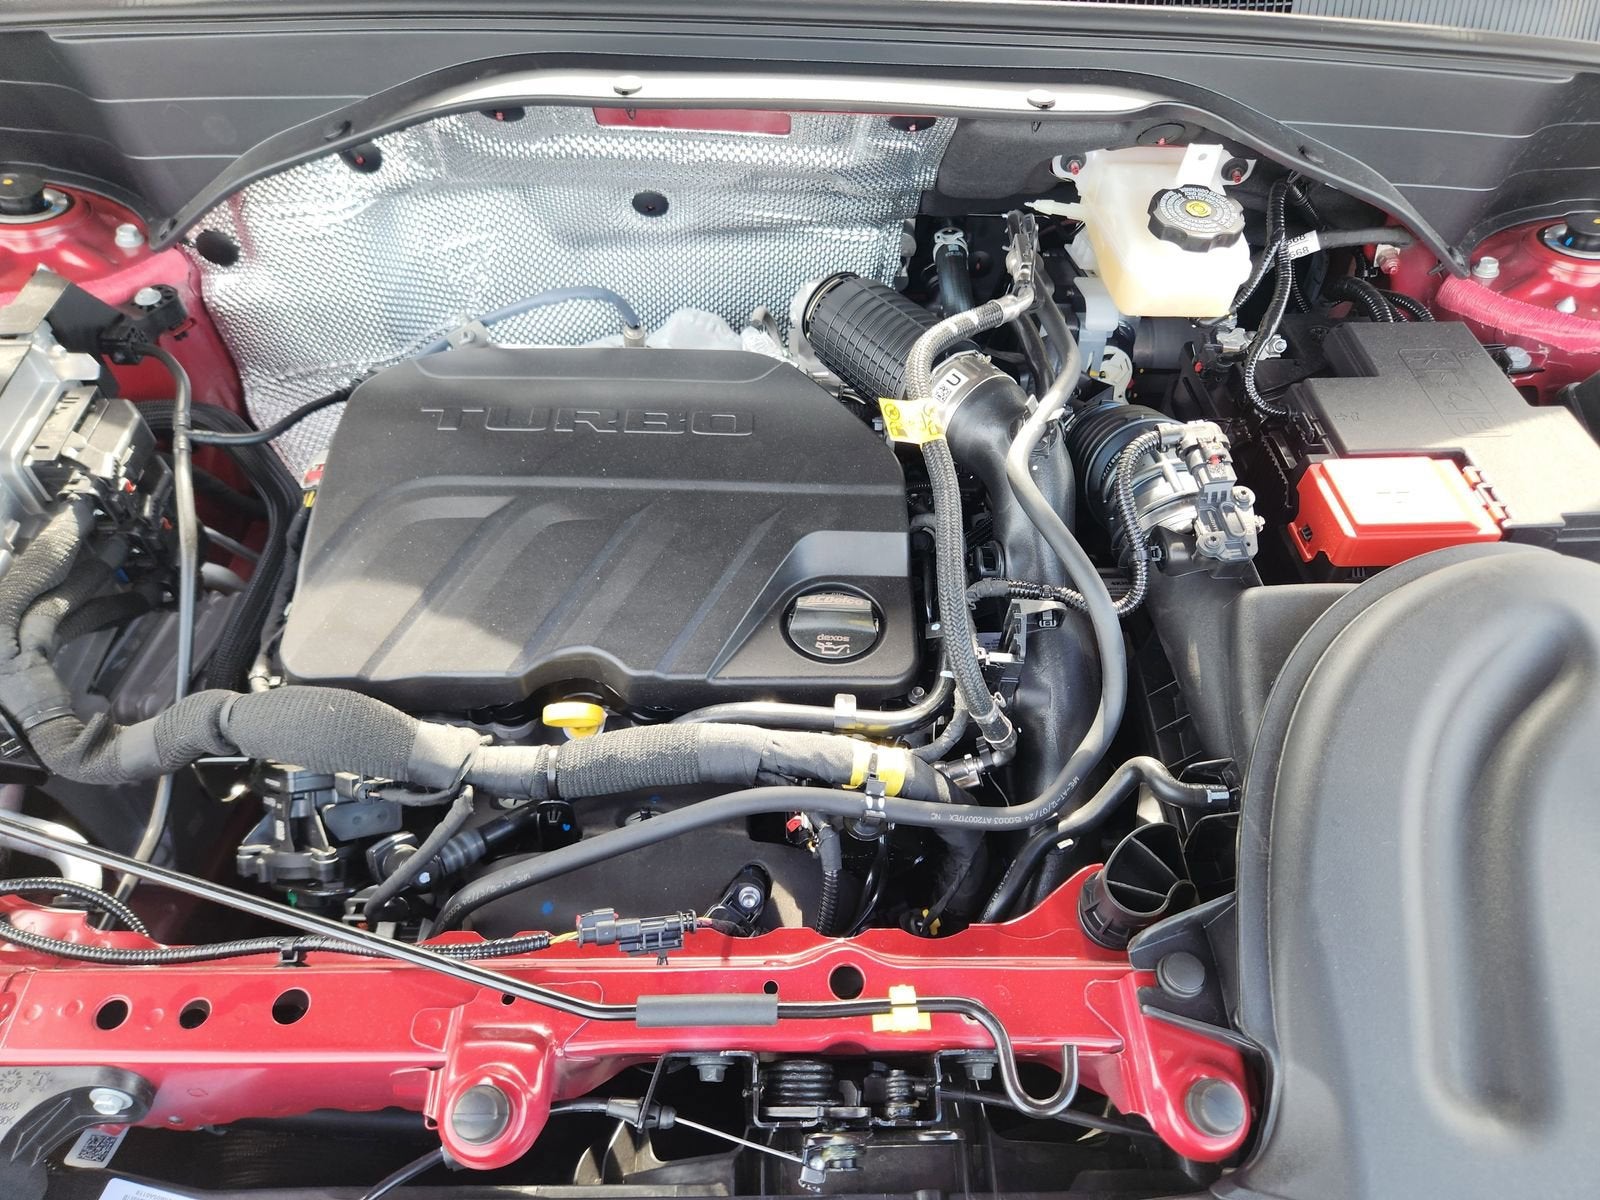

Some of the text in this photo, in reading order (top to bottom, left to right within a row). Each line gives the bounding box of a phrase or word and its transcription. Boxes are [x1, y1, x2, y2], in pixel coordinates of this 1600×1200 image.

[946, 373, 961, 386] U
[420, 407, 754, 436] TURBO
[816, 633, 850, 642] dexos
